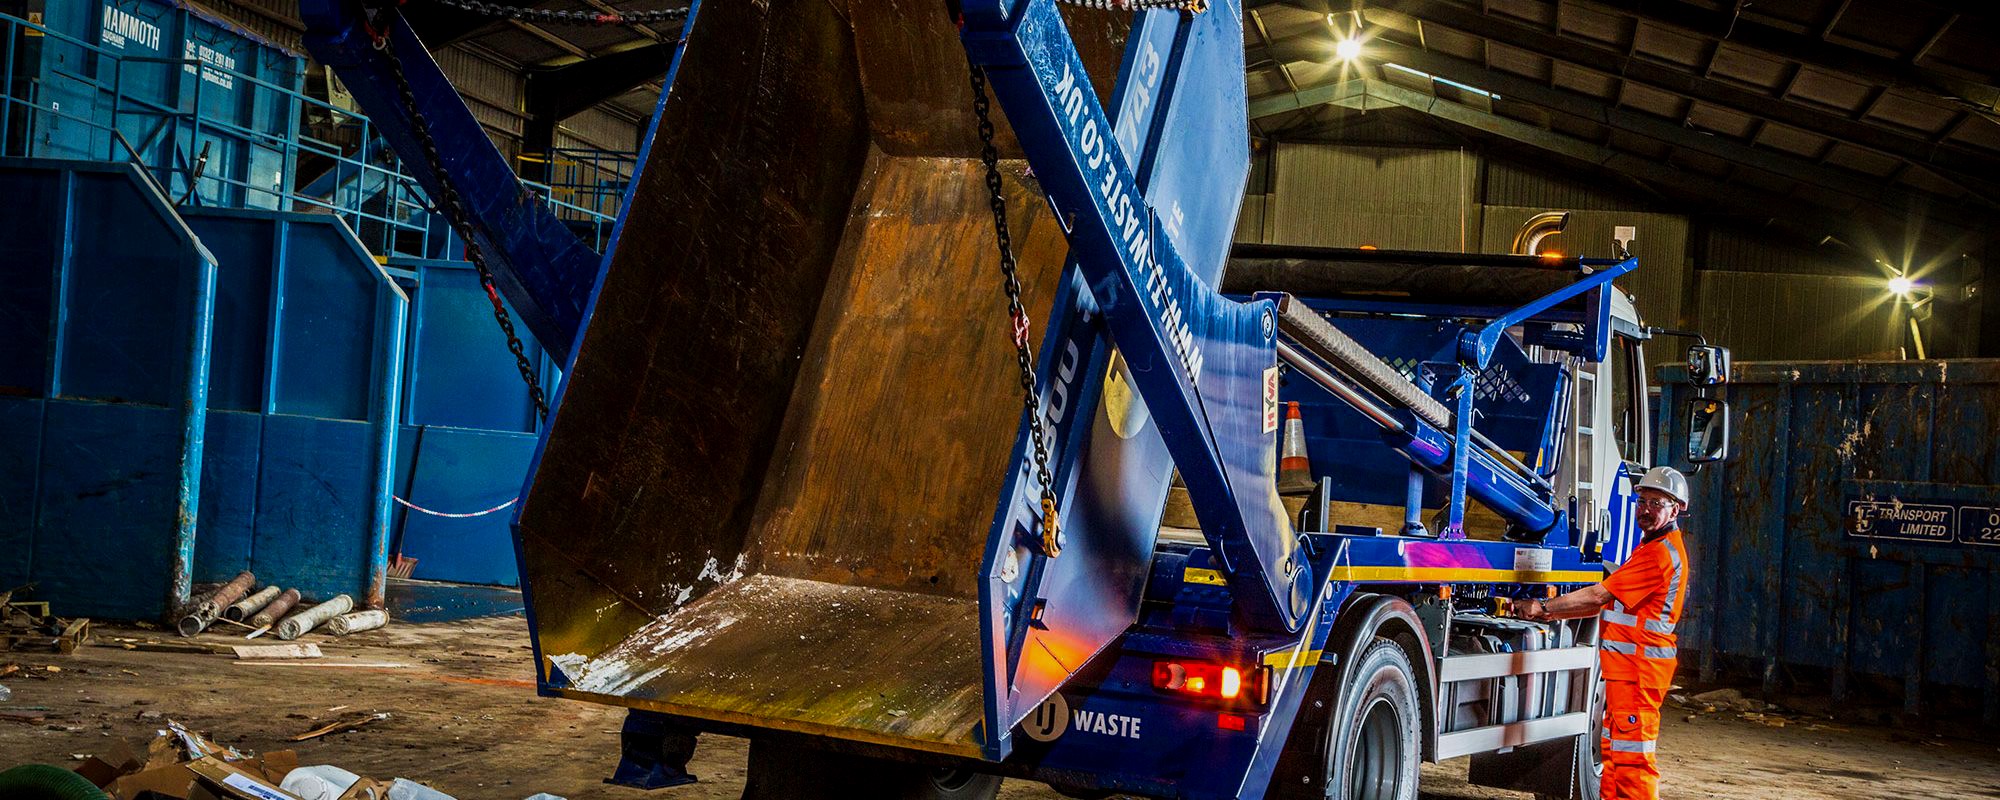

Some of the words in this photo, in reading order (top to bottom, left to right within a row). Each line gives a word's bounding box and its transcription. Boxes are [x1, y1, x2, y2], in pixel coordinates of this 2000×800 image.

[104, 5, 160, 51] MAMMOTH
[1879, 507, 1948, 523] TRANSPORT
[1899, 523, 1947, 537] LIMITED
[1073, 708, 1142, 739] WASTE
